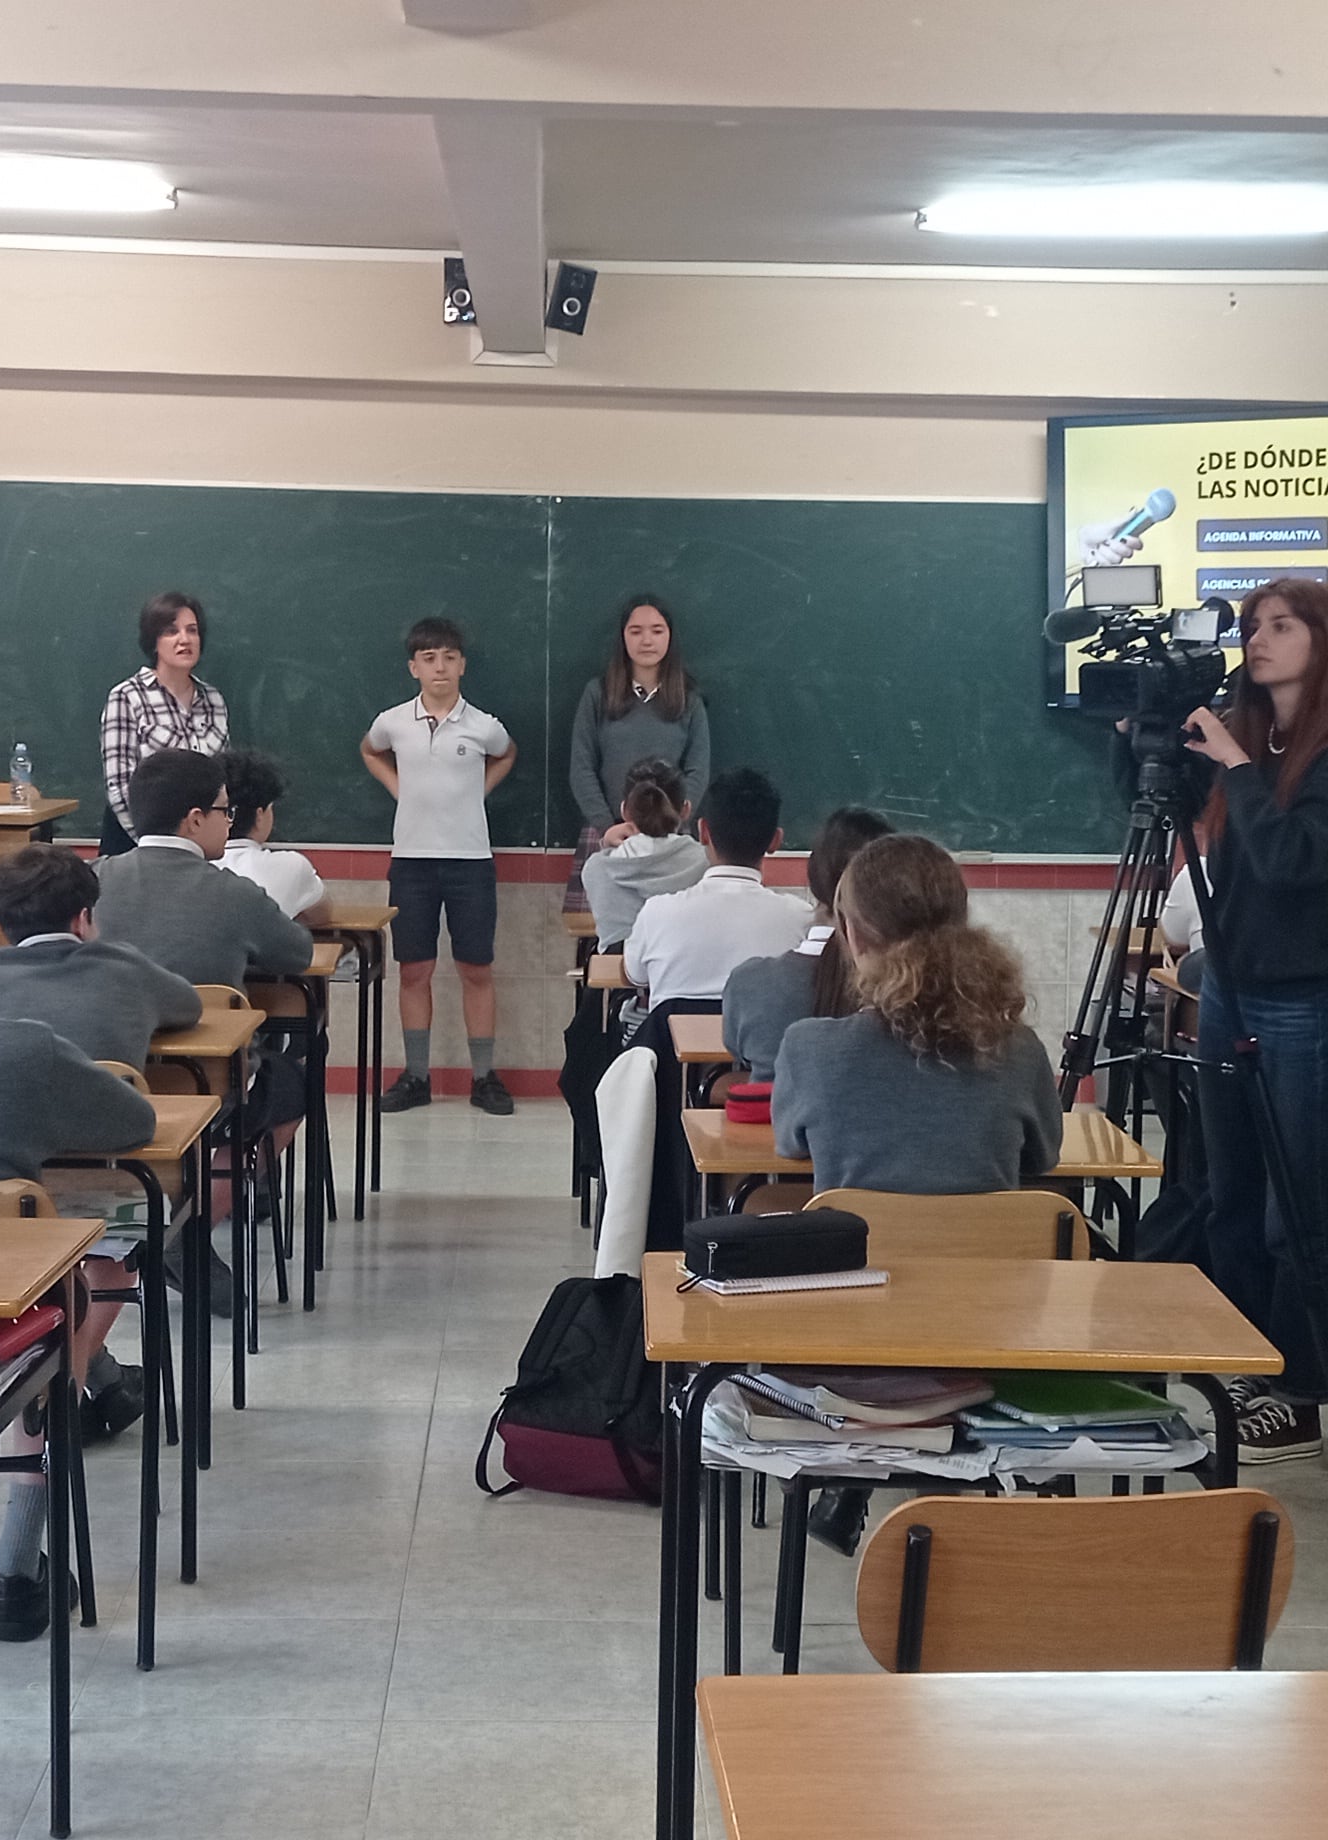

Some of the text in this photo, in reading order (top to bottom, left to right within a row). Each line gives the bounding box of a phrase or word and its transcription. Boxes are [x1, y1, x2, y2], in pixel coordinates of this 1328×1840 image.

[1196, 451, 1237, 475] ¿DE
[1244, 444, 1328, 469] DÓNDE
[1197, 480, 1237, 499] LAS
[1203, 529, 1321, 543] AGENDA INFORMATIVA
[1201, 579, 1257, 590] AGENCIAS
